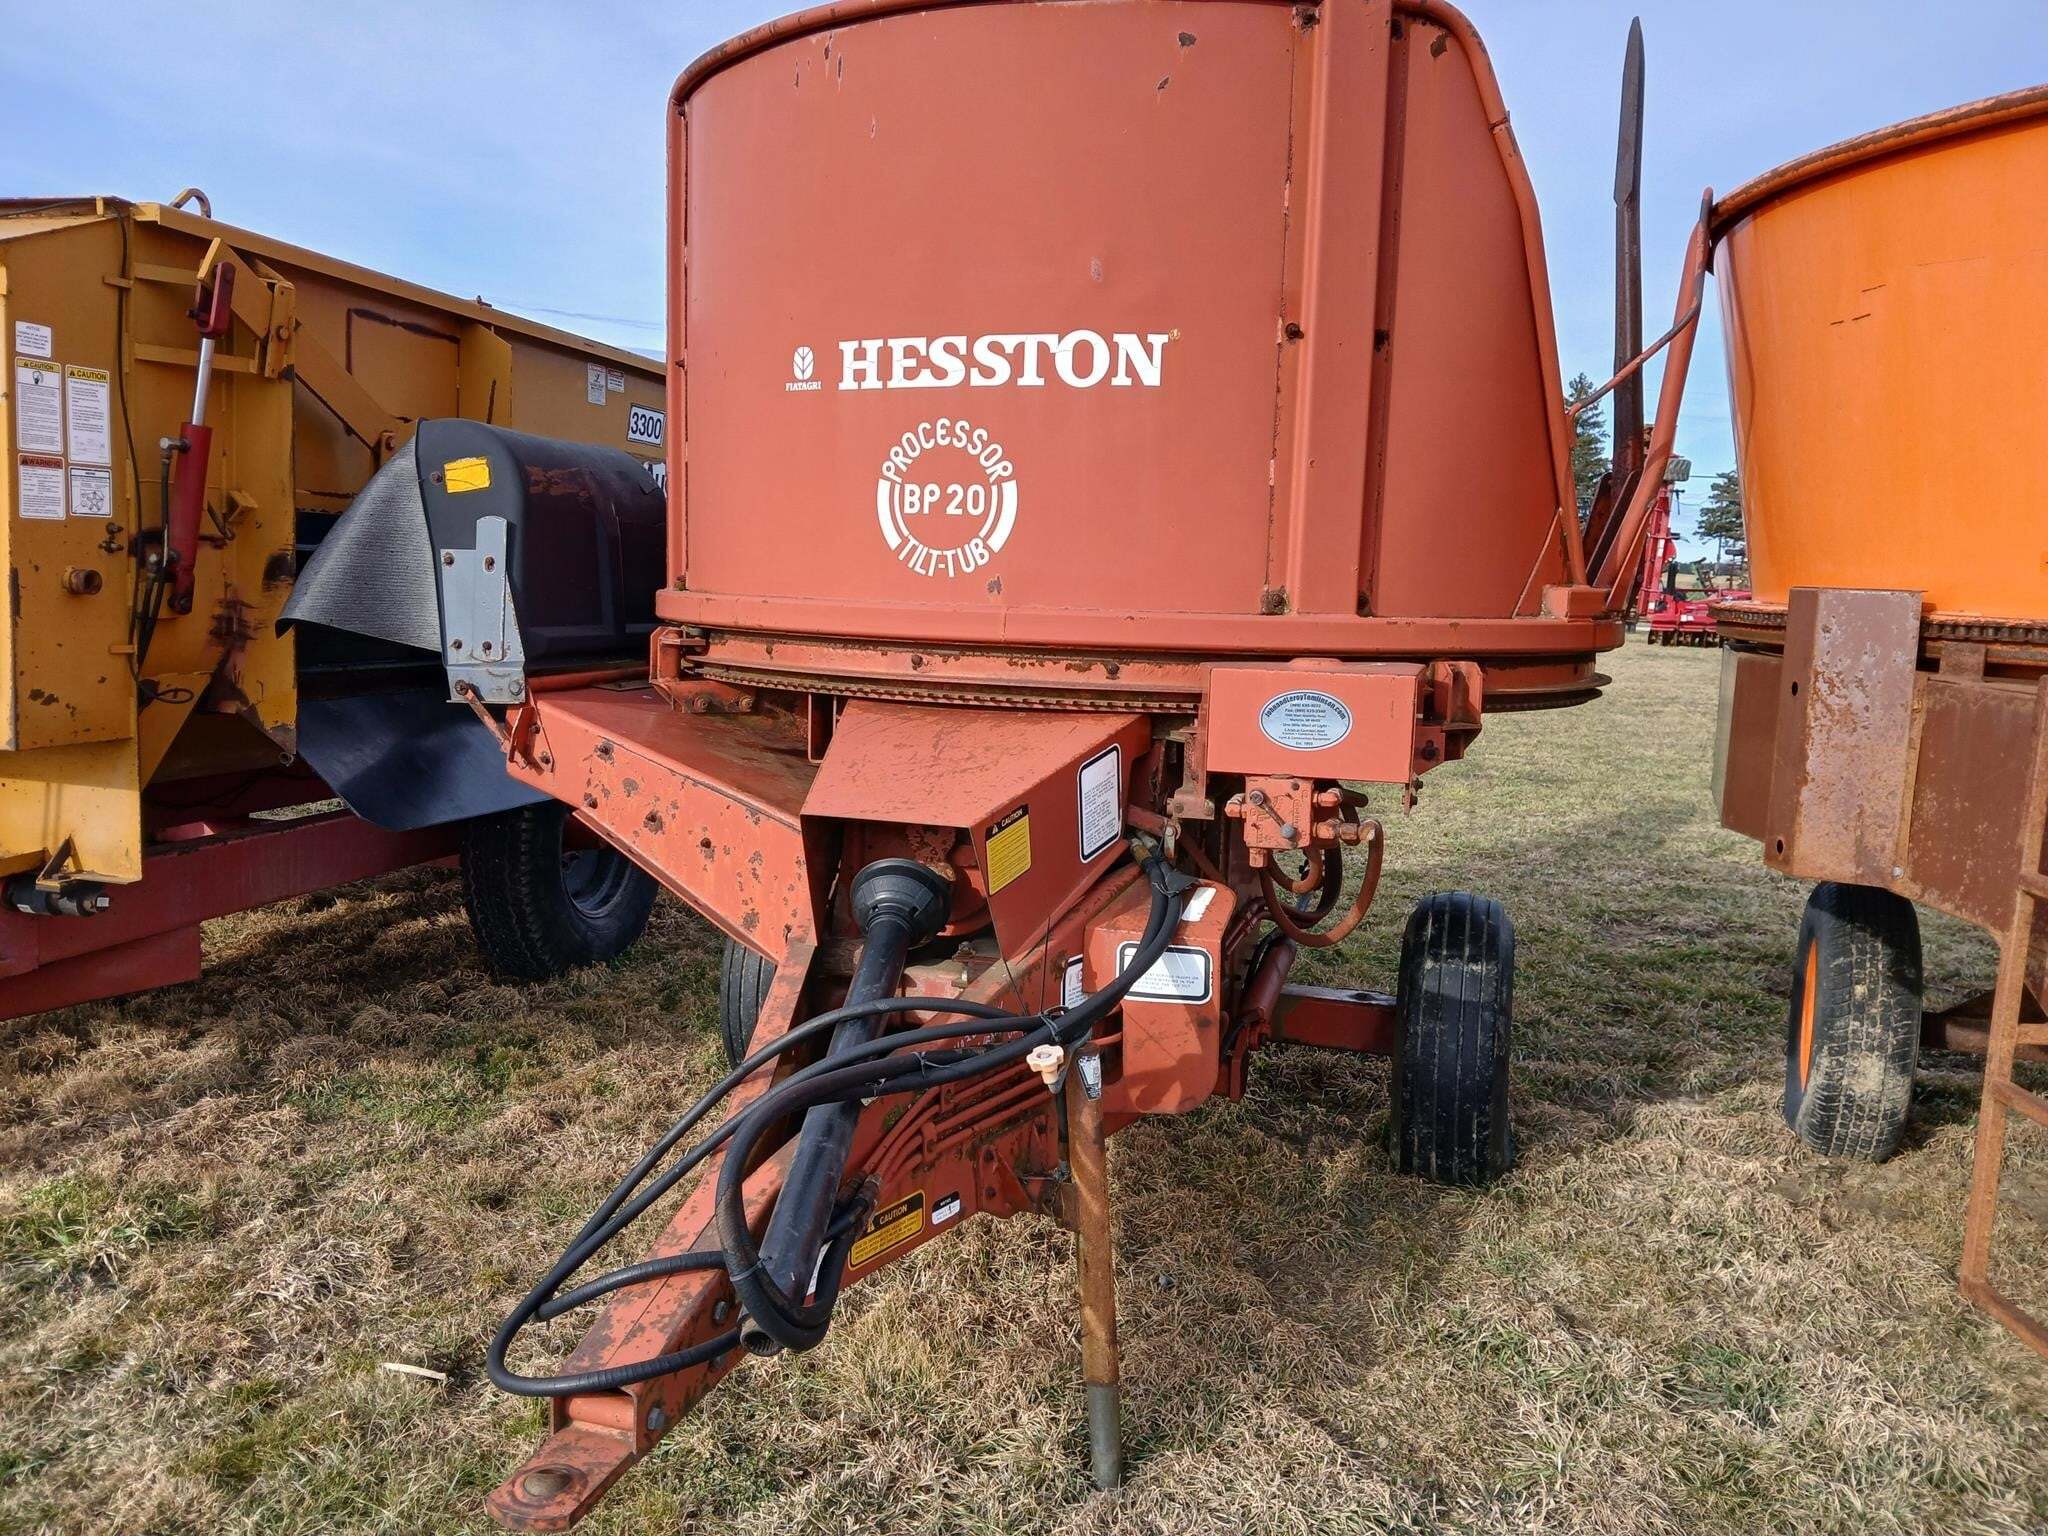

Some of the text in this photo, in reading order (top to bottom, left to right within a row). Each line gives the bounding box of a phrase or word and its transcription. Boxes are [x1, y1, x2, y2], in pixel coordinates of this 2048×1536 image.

[29, 361, 54, 371] CAUTION
[838, 328, 1170, 391] HESSTON
[76, 369, 107, 381] CAUTION
[785, 380, 822, 392] FIATAGRI
[630, 411, 662, 440] 3300
[881, 416, 1014, 484] PROCESSOR
[27, 457, 62, 468] WARNING
[904, 483, 986, 516] BP 20
[898, 533, 990, 578] TILT-TUB
[1001, 807, 1023, 827] CAUTION
[879, 1203, 908, 1225] CAUTION
